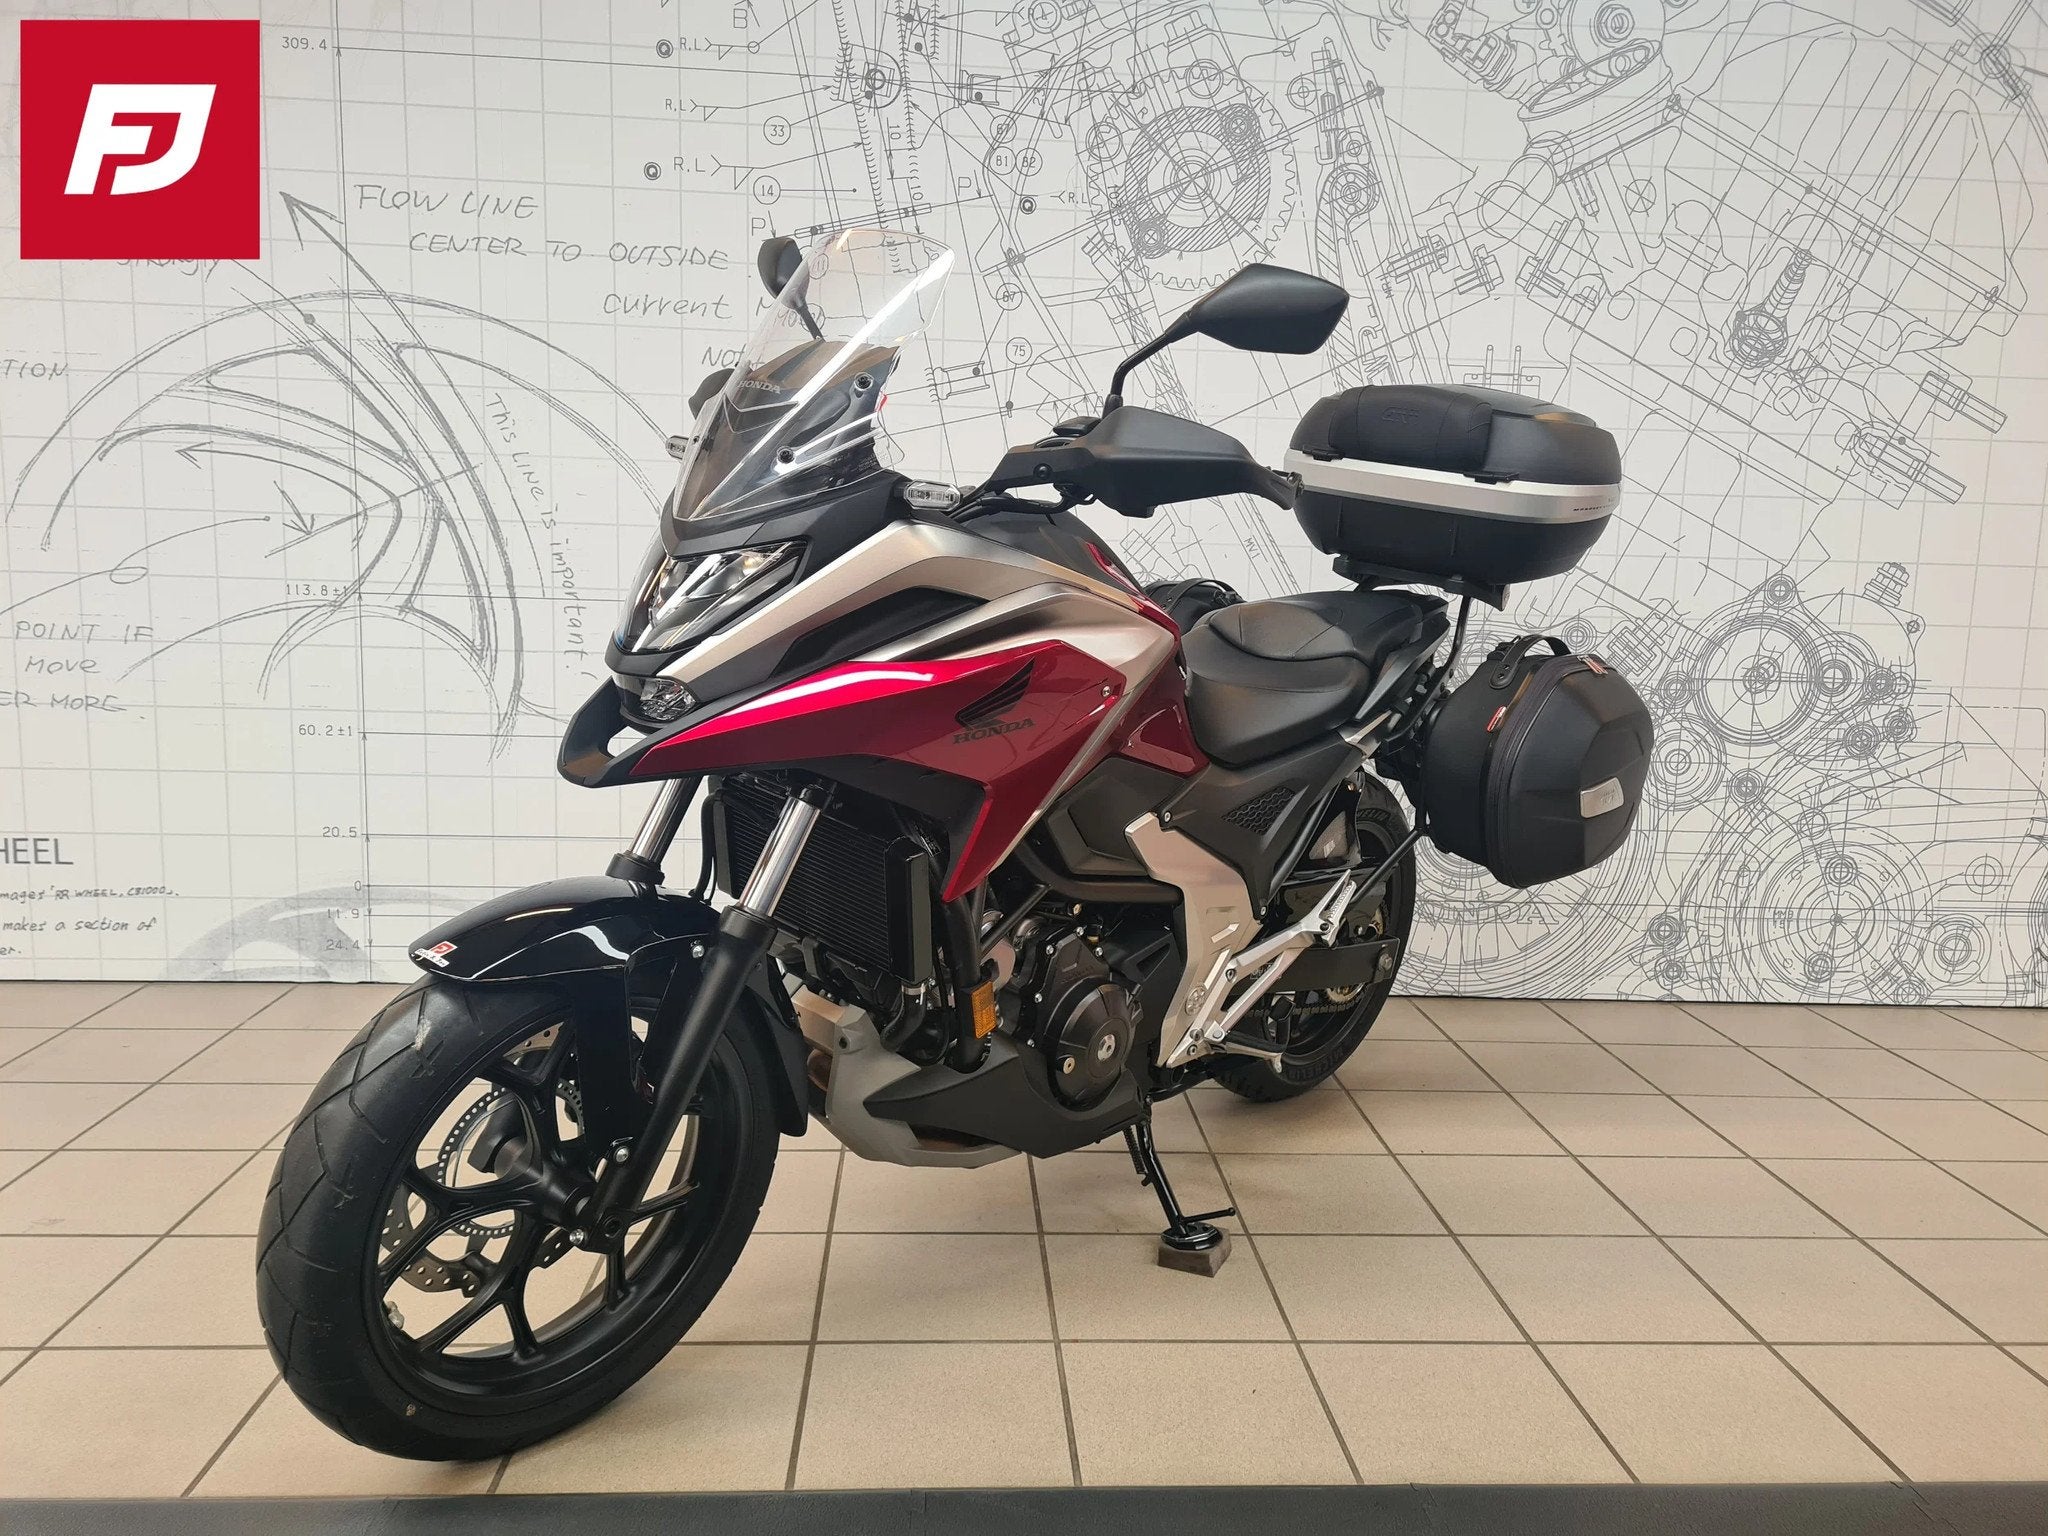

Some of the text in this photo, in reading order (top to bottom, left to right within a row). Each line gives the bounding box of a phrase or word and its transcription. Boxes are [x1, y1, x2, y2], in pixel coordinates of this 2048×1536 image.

[733, 8, 748, 29] B
[281, 36, 327, 51] 309.4
[770, 124, 785, 138] 33
[889, 124, 902, 141] 10
[761, 184, 775, 197] 14
[910, 185, 924, 201] 10
[957, 177, 972, 197] P
[353, 184, 539, 219] FLOW LINE
[751, 218, 765, 236] P
[409, 232, 729, 270] CENTER TO OUTSIDE
[1012, 344, 1027, 357] 75
[737, 380, 781, 395] HONDA
[16, 620, 154, 644] POINT IF
[953, 718, 1036, 745] HONDA
[322, 826, 357, 839] 20.5
[354, 880, 362, 892] 0
[327, 908, 360, 919] 11.9
[3, 915, 157, 932] makes a section of
[325, 939, 360, 951] 24.4
